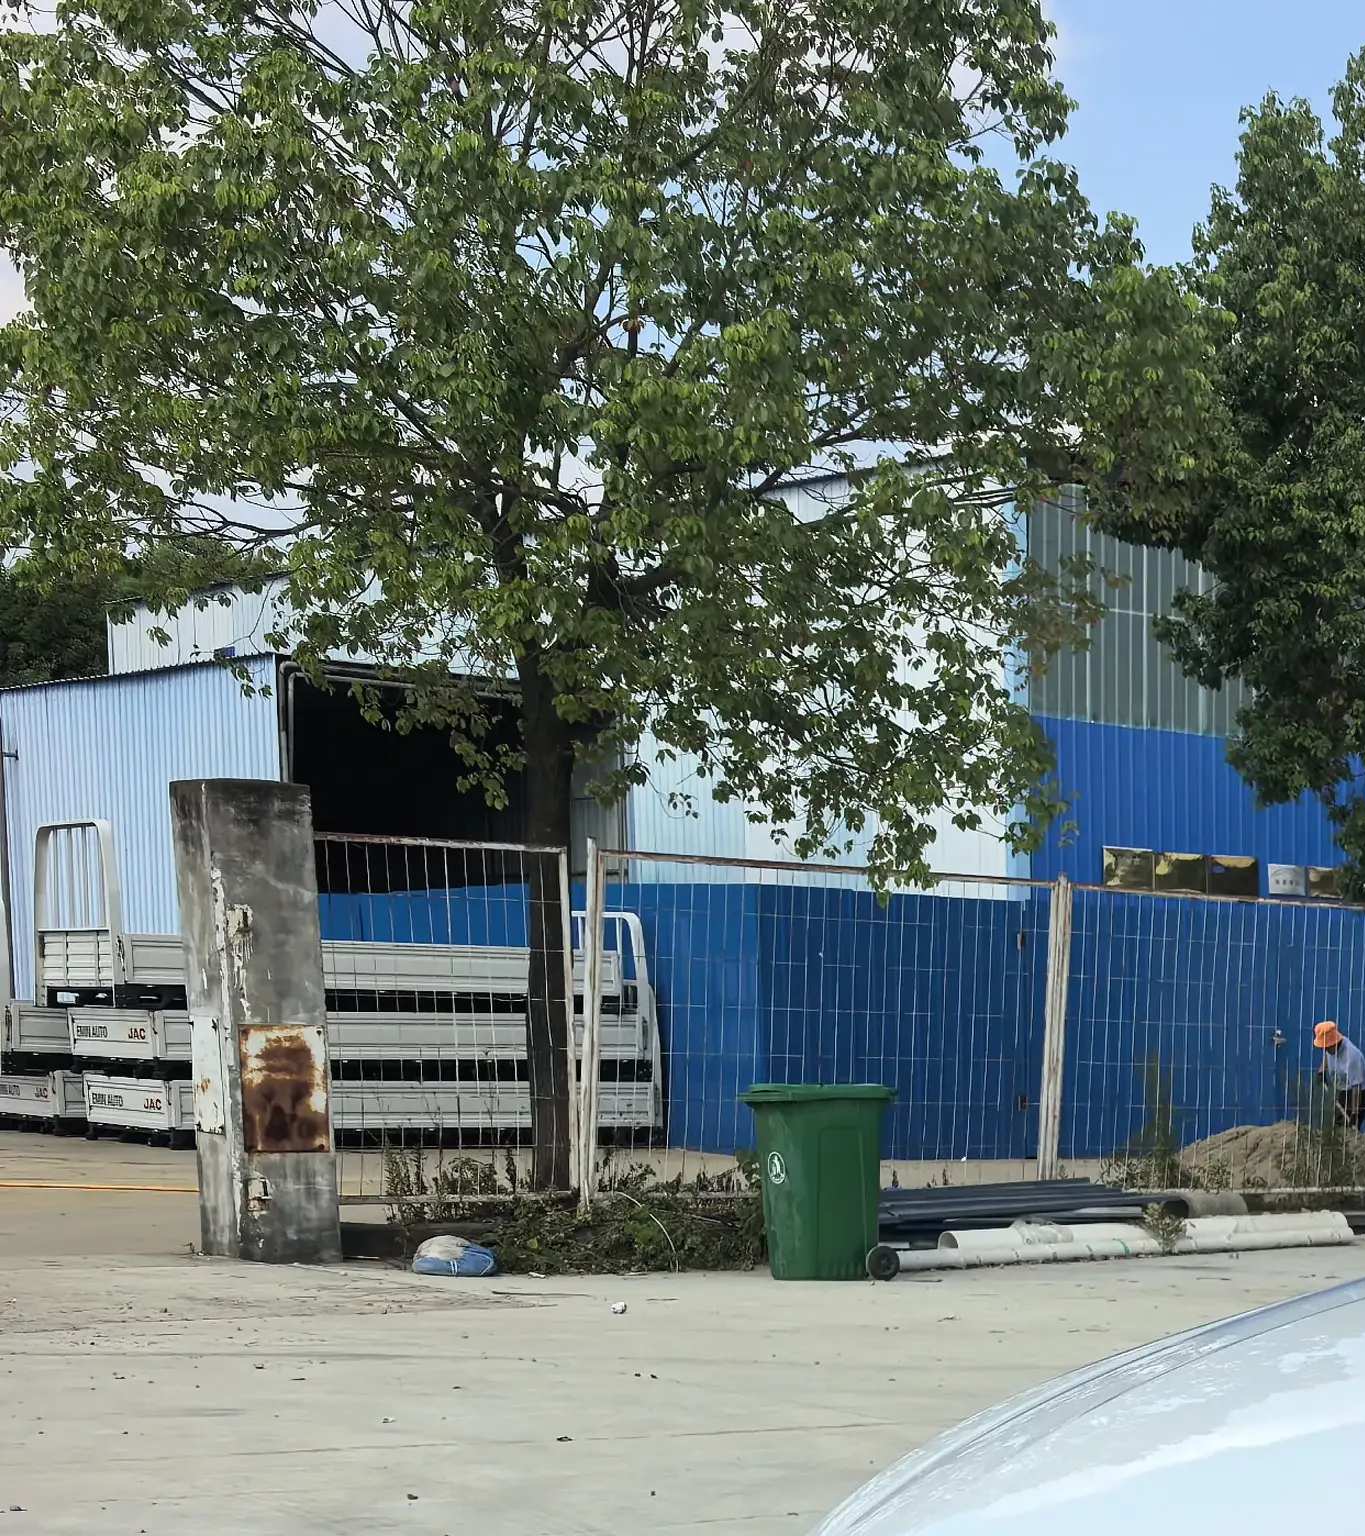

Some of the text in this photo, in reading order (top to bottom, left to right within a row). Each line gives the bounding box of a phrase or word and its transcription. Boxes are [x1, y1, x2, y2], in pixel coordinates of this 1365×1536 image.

[128, 1027, 146, 1040] JAC
[34, 1086, 48, 1099] JAC
[143, 1098, 162, 1110] JAC
